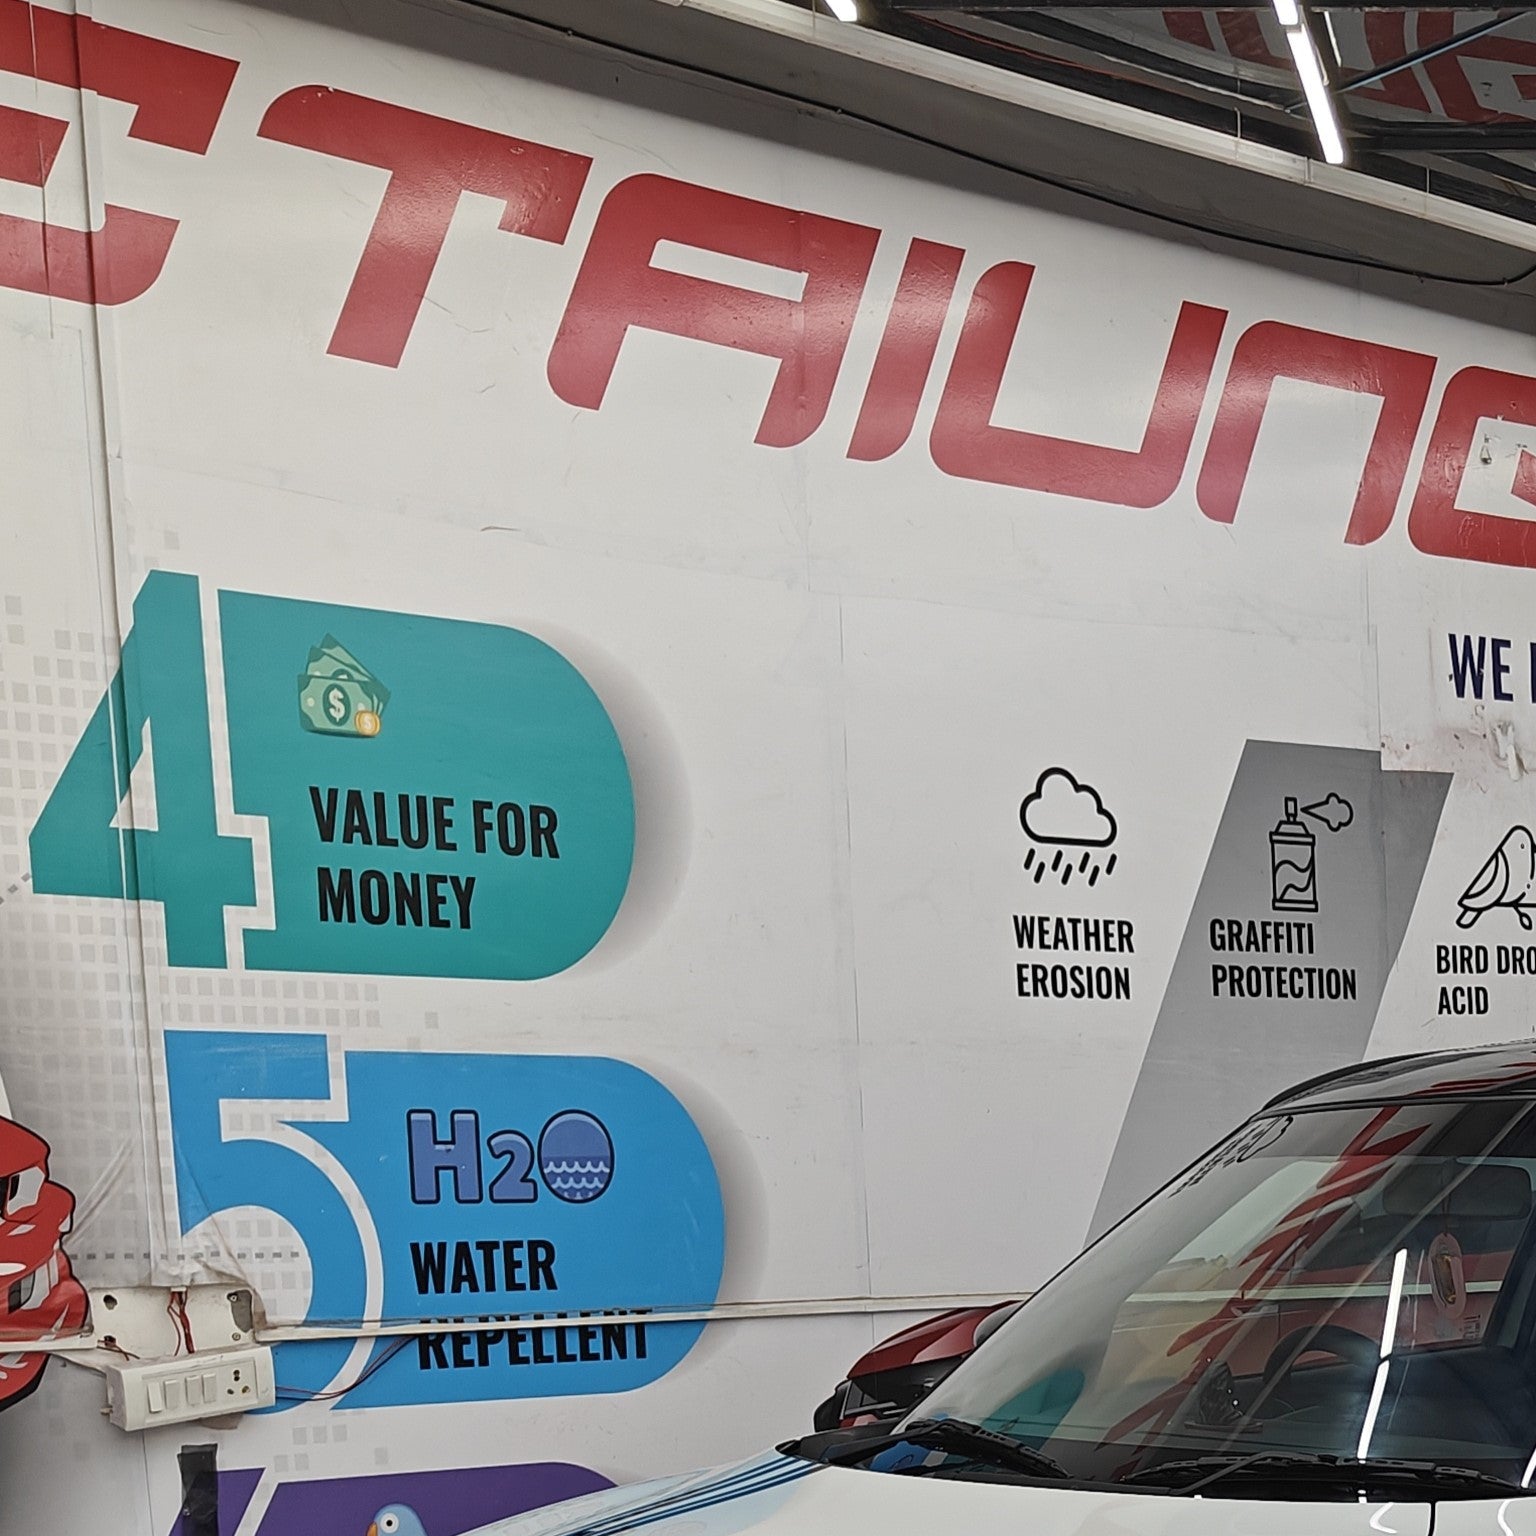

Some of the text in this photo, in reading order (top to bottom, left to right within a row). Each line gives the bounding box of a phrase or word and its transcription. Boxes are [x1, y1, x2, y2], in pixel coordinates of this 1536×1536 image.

[1448, 633, 1515, 703] WE
[29, 569, 258, 969] 4
[309, 785, 560, 859] VALUE FOR
[317, 867, 477, 930] MONEY
[1013, 915, 1135, 953] WEATHER
[1209, 919, 1315, 955] GRAFFITI
[1436, 945, 1489, 975] BIRD
[1016, 964, 1131, 1000] EROSION
[1212, 965, 1357, 1000] PROTECTION
[1437, 986, 1489, 1016] ACID
[406, 1108, 616, 1205] H2O
[164, 1030, 370, 1414] 5
[410, 1239, 558, 1296] WATER
[418, 1309, 653, 1371] REPELLENT
